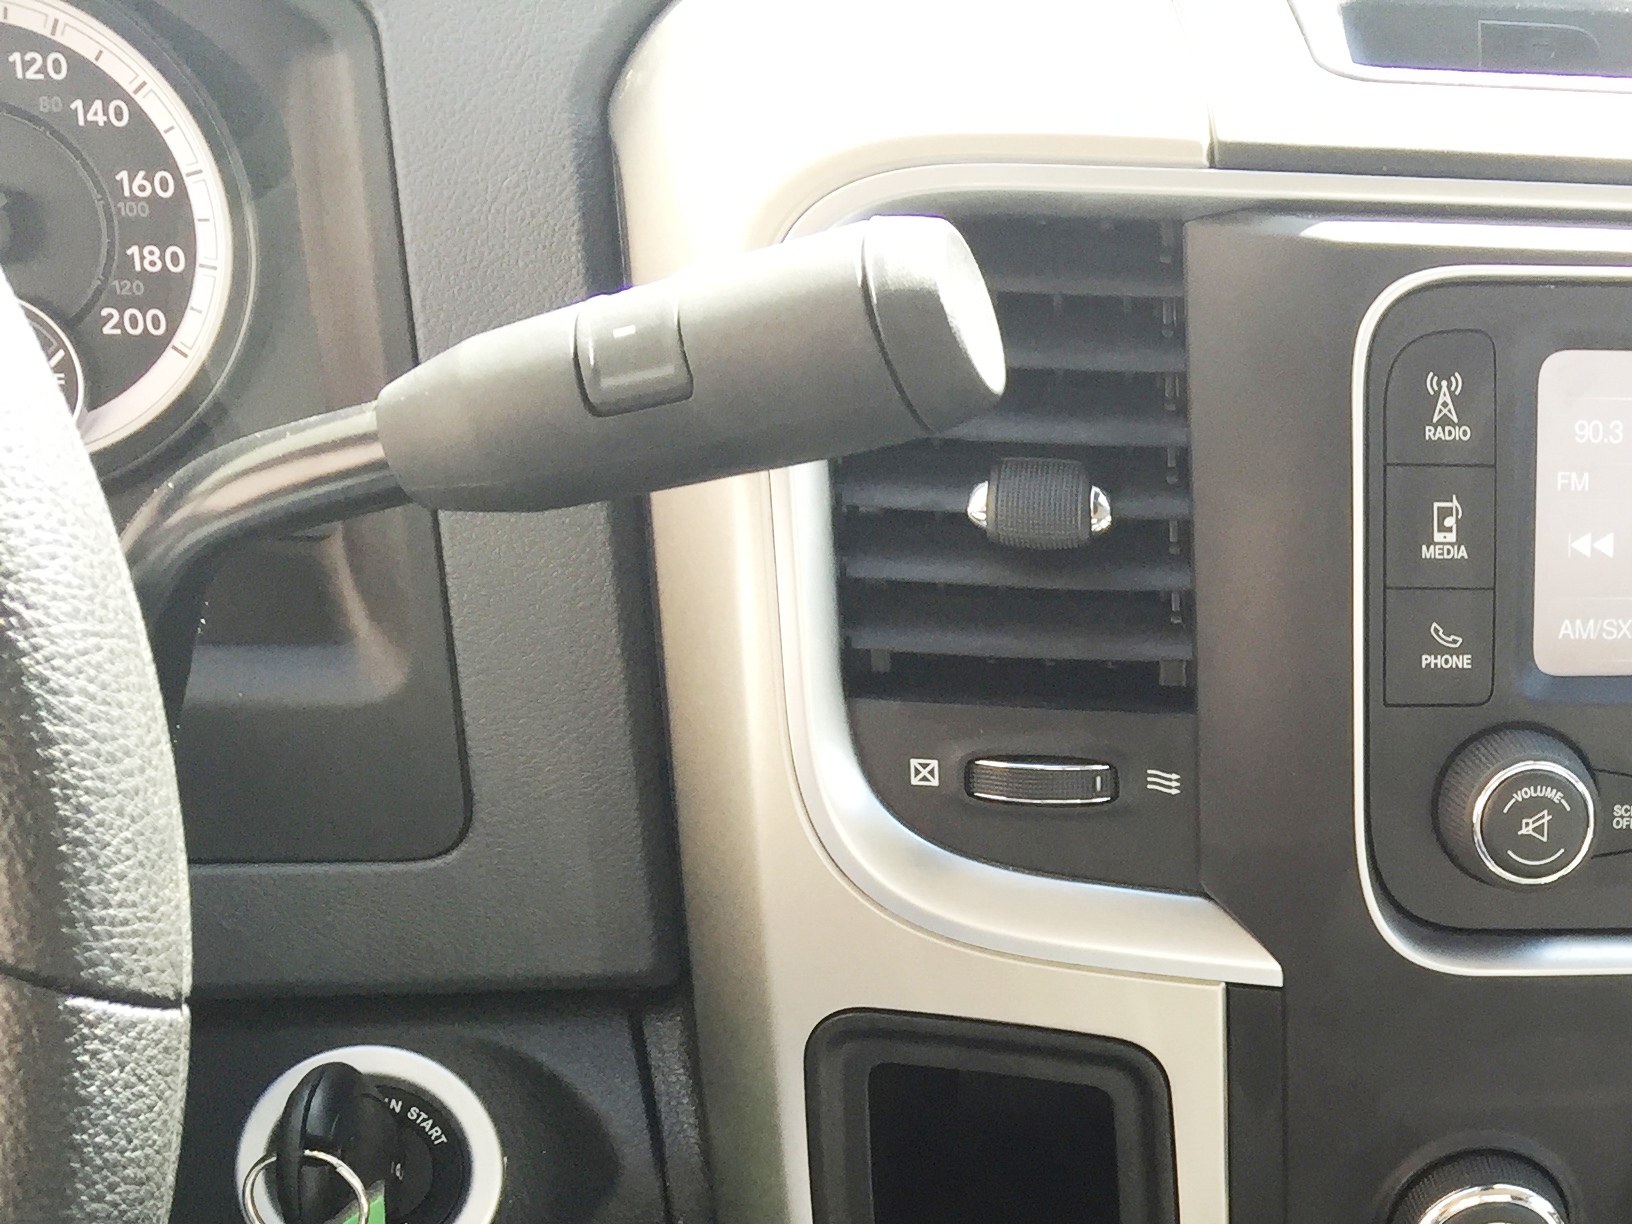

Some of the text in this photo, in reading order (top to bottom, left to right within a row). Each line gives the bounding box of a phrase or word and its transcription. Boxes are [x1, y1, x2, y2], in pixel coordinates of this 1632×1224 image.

[8, 52, 67, 80] 120
[39, 97, 63, 112] 80
[70, 99, 130, 127] 140
[115, 170, 175, 198] 160
[117, 202, 149, 217] 100
[126, 245, 185, 273] 180
[112, 279, 144, 295] 120
[101, 308, 166, 335] 200
[1425, 426, 1471, 441] RADIO
[1574, 420, 1624, 444] 90.3
[1557, 472, 1590, 491] FM
[1421, 544, 1468, 560] MEDIA
[1421, 655, 1472, 669] PHONE
[1512, 785, 1564, 805] VOLUME
[407, 1106, 448, 1145] START
